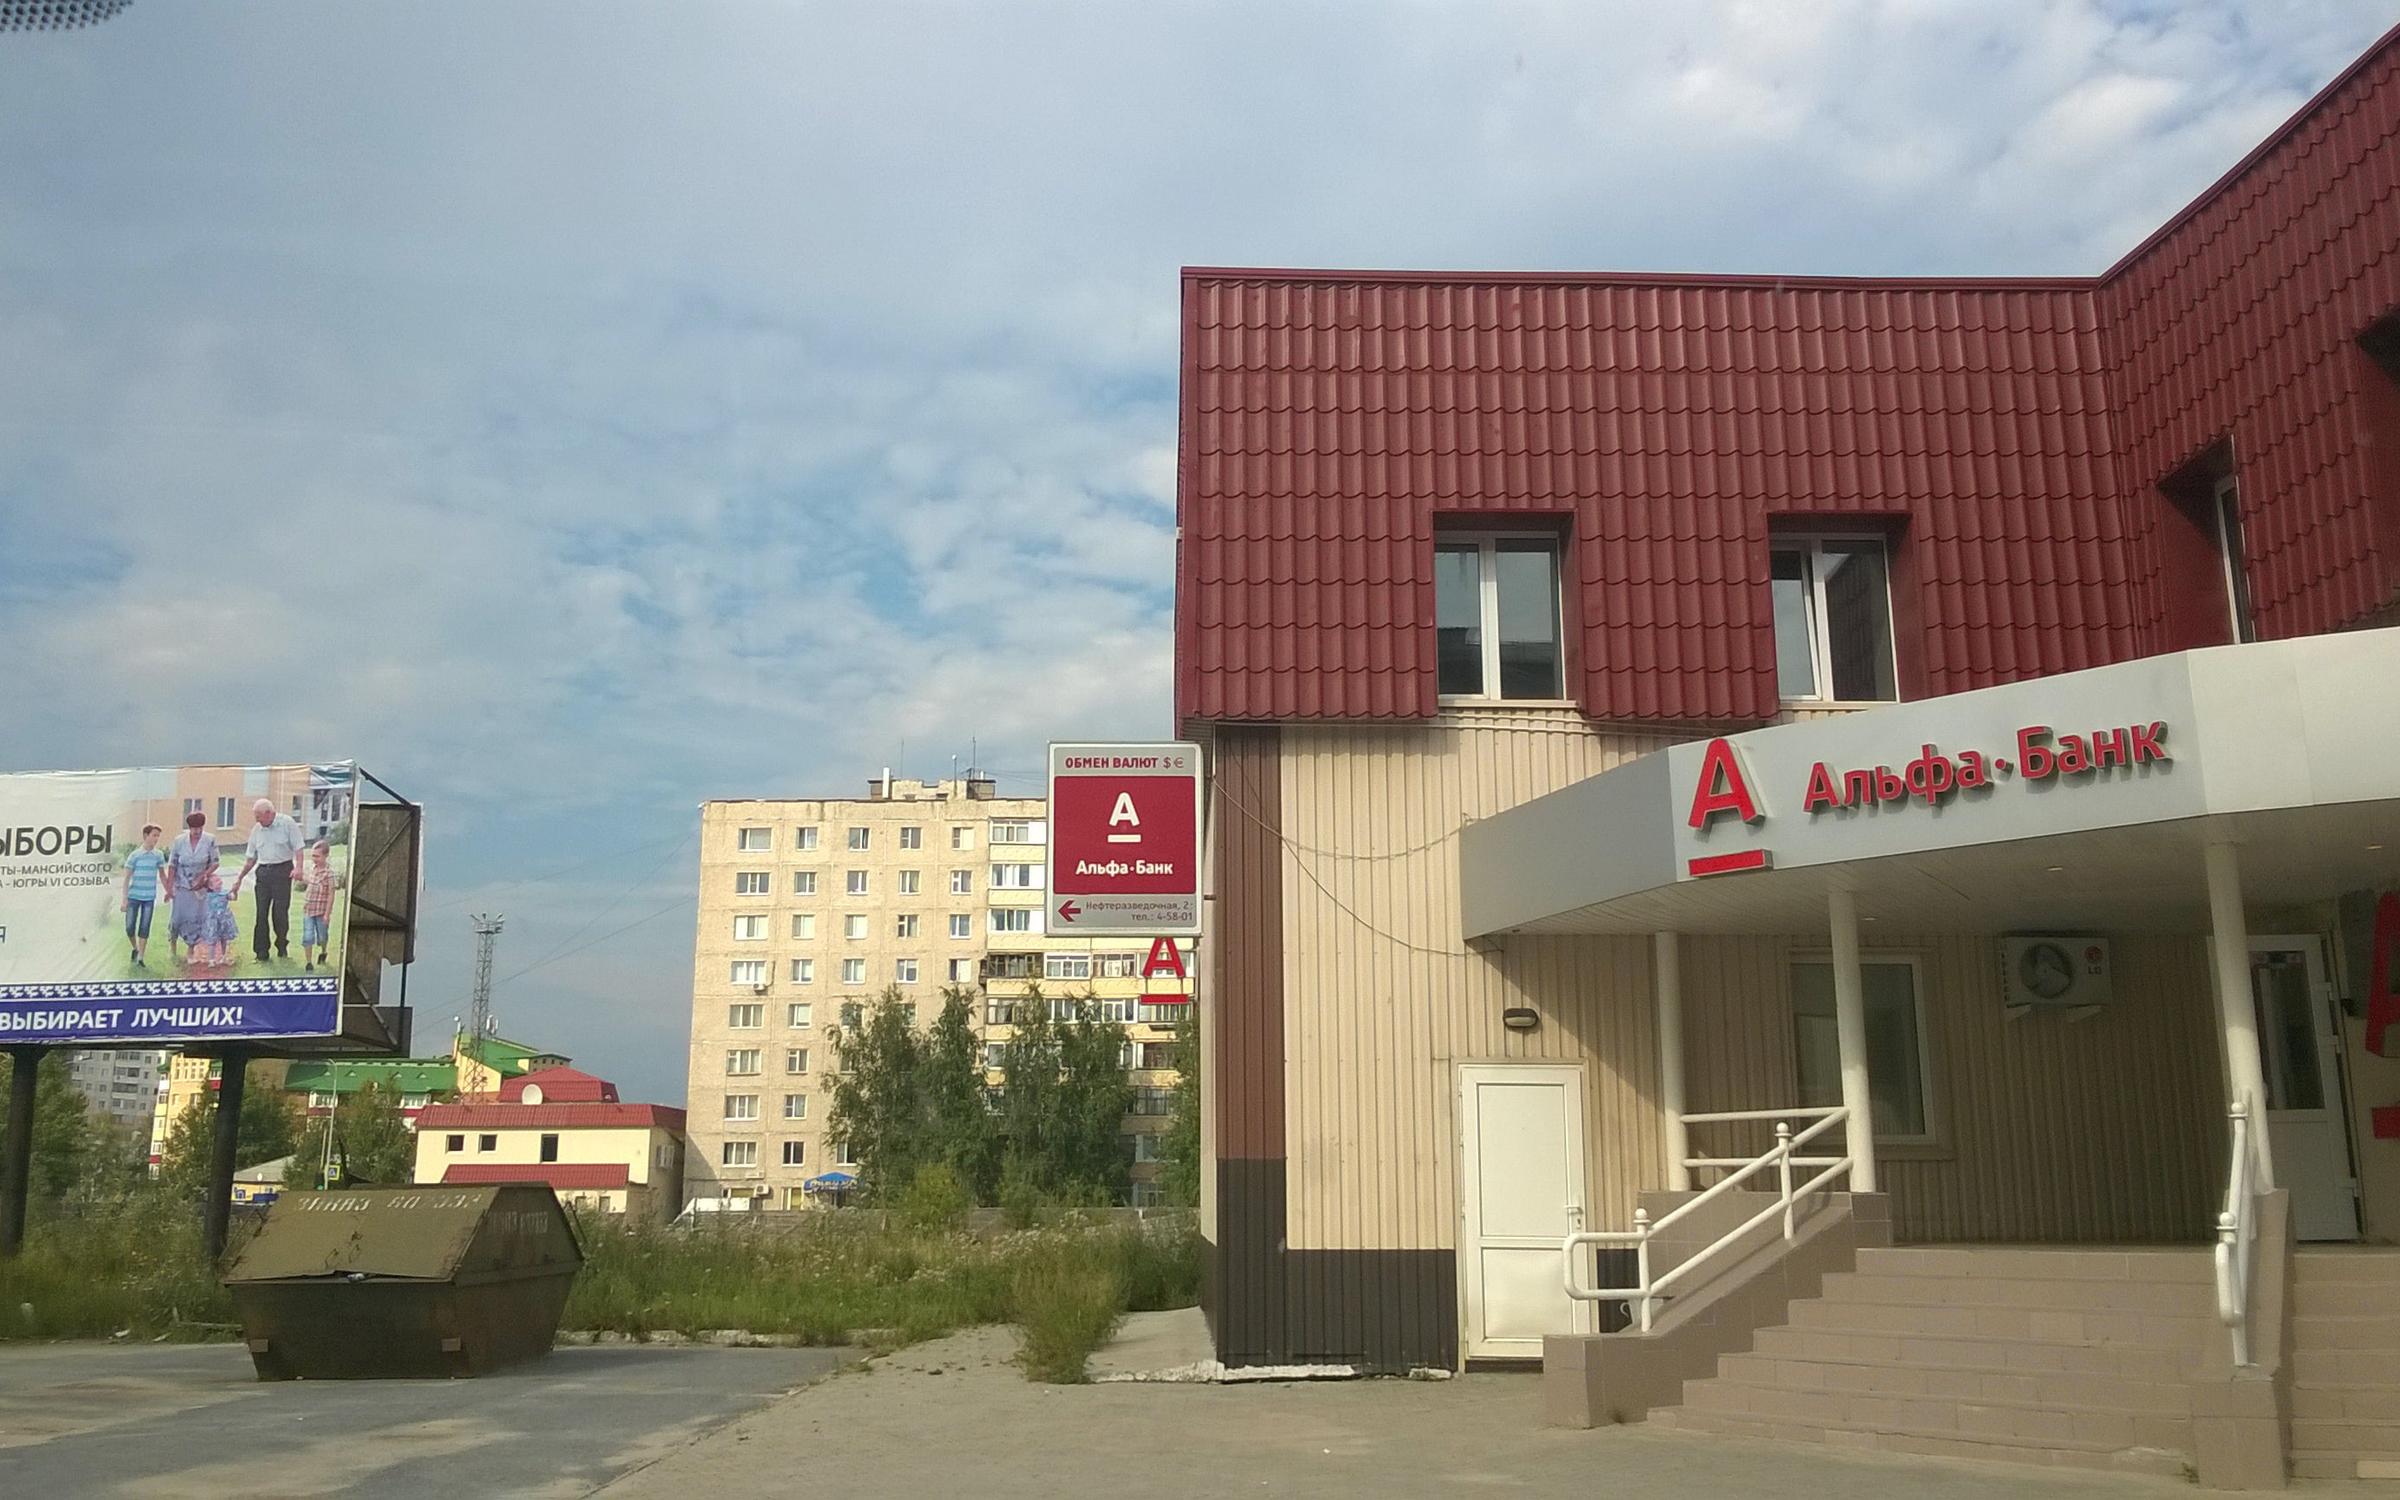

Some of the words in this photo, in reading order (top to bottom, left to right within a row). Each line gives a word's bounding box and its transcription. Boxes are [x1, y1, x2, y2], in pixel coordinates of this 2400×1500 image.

[1065, 757, 1109, 769] ОБМЕН
[1113, 757, 1158, 769] ВАЛЮТ
[1687, 737, 1763, 830] А
[1108, 791, 1140, 827] А
[13, 878, 47, 889] ЮГРЫ
[50, 877, 60, 887] VI
[63, 876, 111, 887] СОЗЫВА
[1157, 911, 1193, 922] 4-58-01
[0, 1009, 123, 1031] ВЫБИРАЕТ
[131, 1006, 243, 1028] ЛУЧШИХ!
